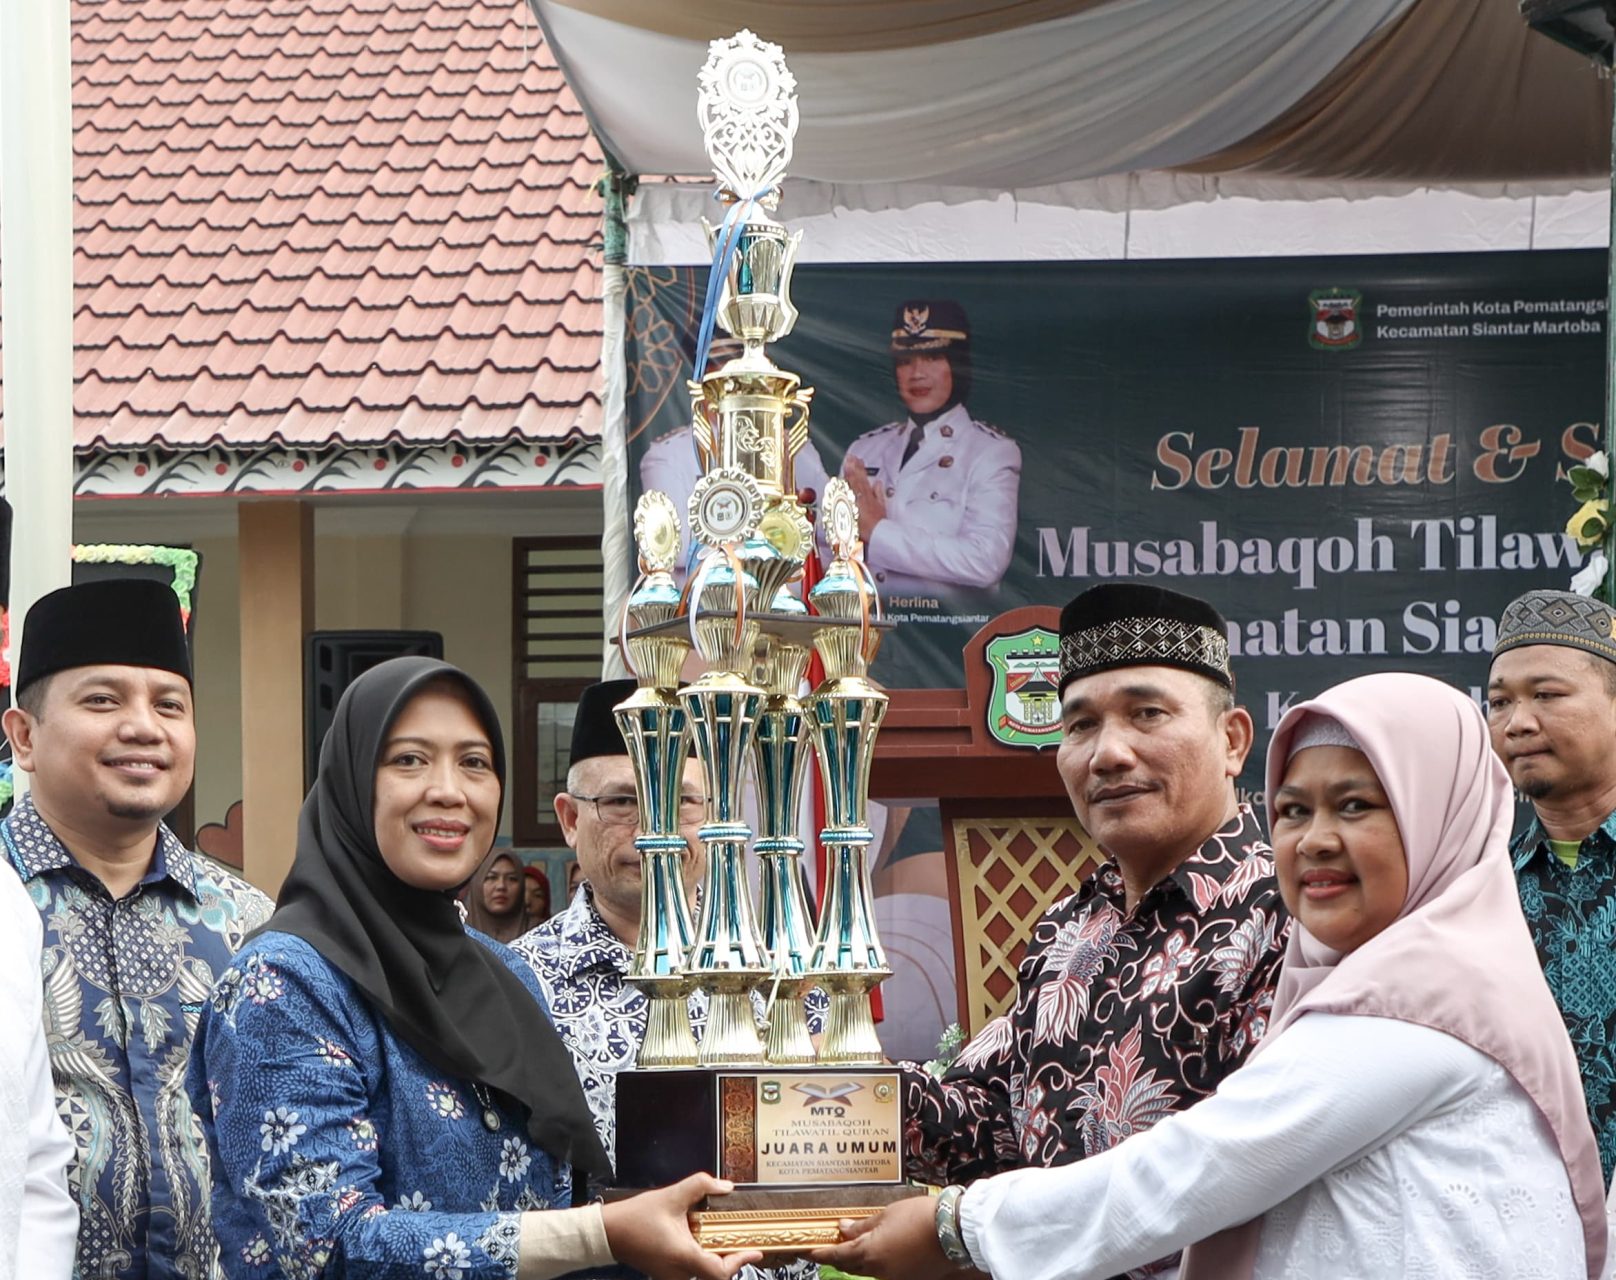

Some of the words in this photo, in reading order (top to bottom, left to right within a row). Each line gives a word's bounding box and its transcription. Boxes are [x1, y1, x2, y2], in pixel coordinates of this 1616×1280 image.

[1376, 303, 1469, 317] Pemerintah
[1473, 301, 1510, 315] Kota
[1376, 324, 1469, 339] Kecamatan
[1472, 321, 1530, 336] Siantar
[1533, 319, 1601, 334] Martoba
[1151, 426, 1456, 491] Selamat
[1473, 424, 1541, 483] &
[1036, 517, 1398, 590] Musabaqoh
[889, 596, 939, 609] Herlina
[887, 613, 909, 622] Kota
[910, 613, 990, 625] Pematangsiantar
[811, 1107, 845, 1118] MTQ
[791, 1119, 871, 1127] MUSABAQOH
[773, 1128, 839, 1137] TILAWATIL
[761, 1142, 828, 1155] JUARA
[836, 1141, 896, 1153] UMUM
[766, 1160, 814, 1168] KECAMATAN
[853, 1159, 891, 1167] MARTOBA
[778, 1168, 799, 1176] KOTA
[801, 1166, 879, 1176] PEMATANGSIANTAR
